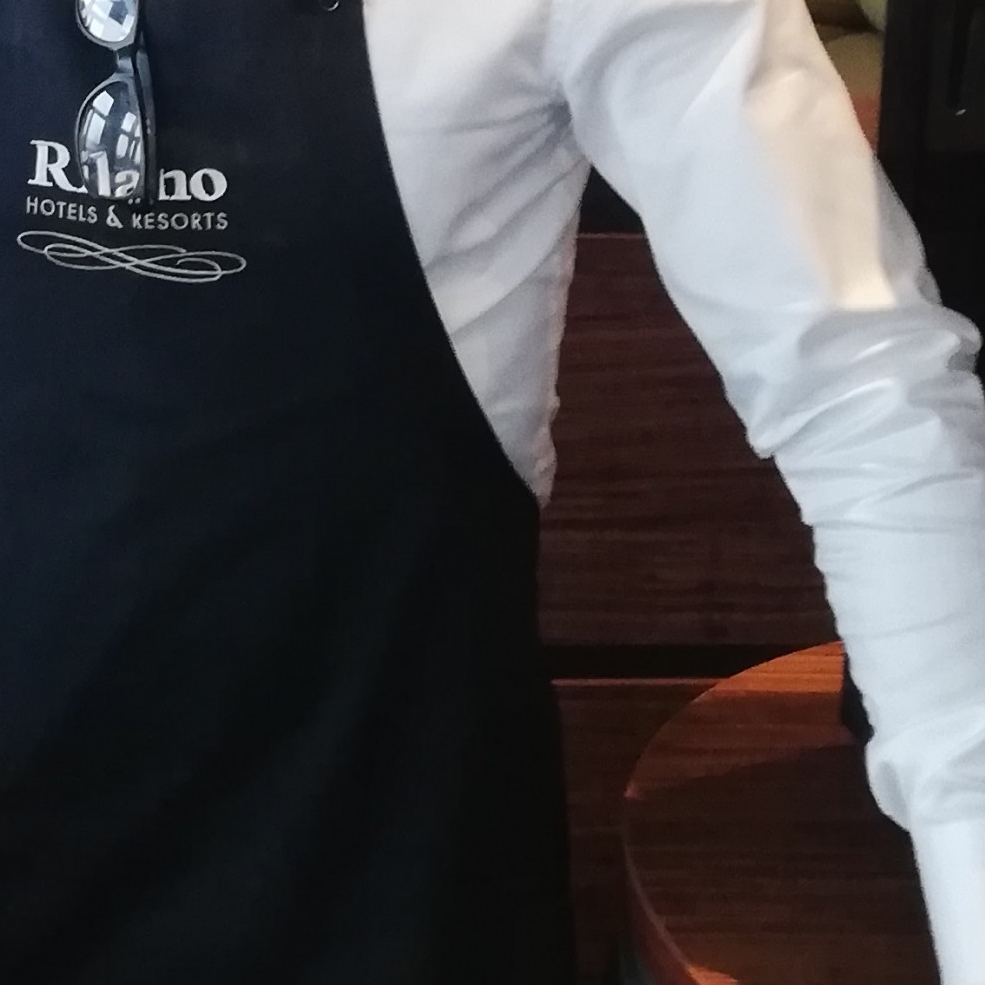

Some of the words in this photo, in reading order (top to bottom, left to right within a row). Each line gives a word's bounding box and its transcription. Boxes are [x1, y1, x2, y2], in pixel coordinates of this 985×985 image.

[26, 196, 98, 224] HOTELS
[105, 204, 124, 229] &
[132, 212, 229, 230] RESORTS
